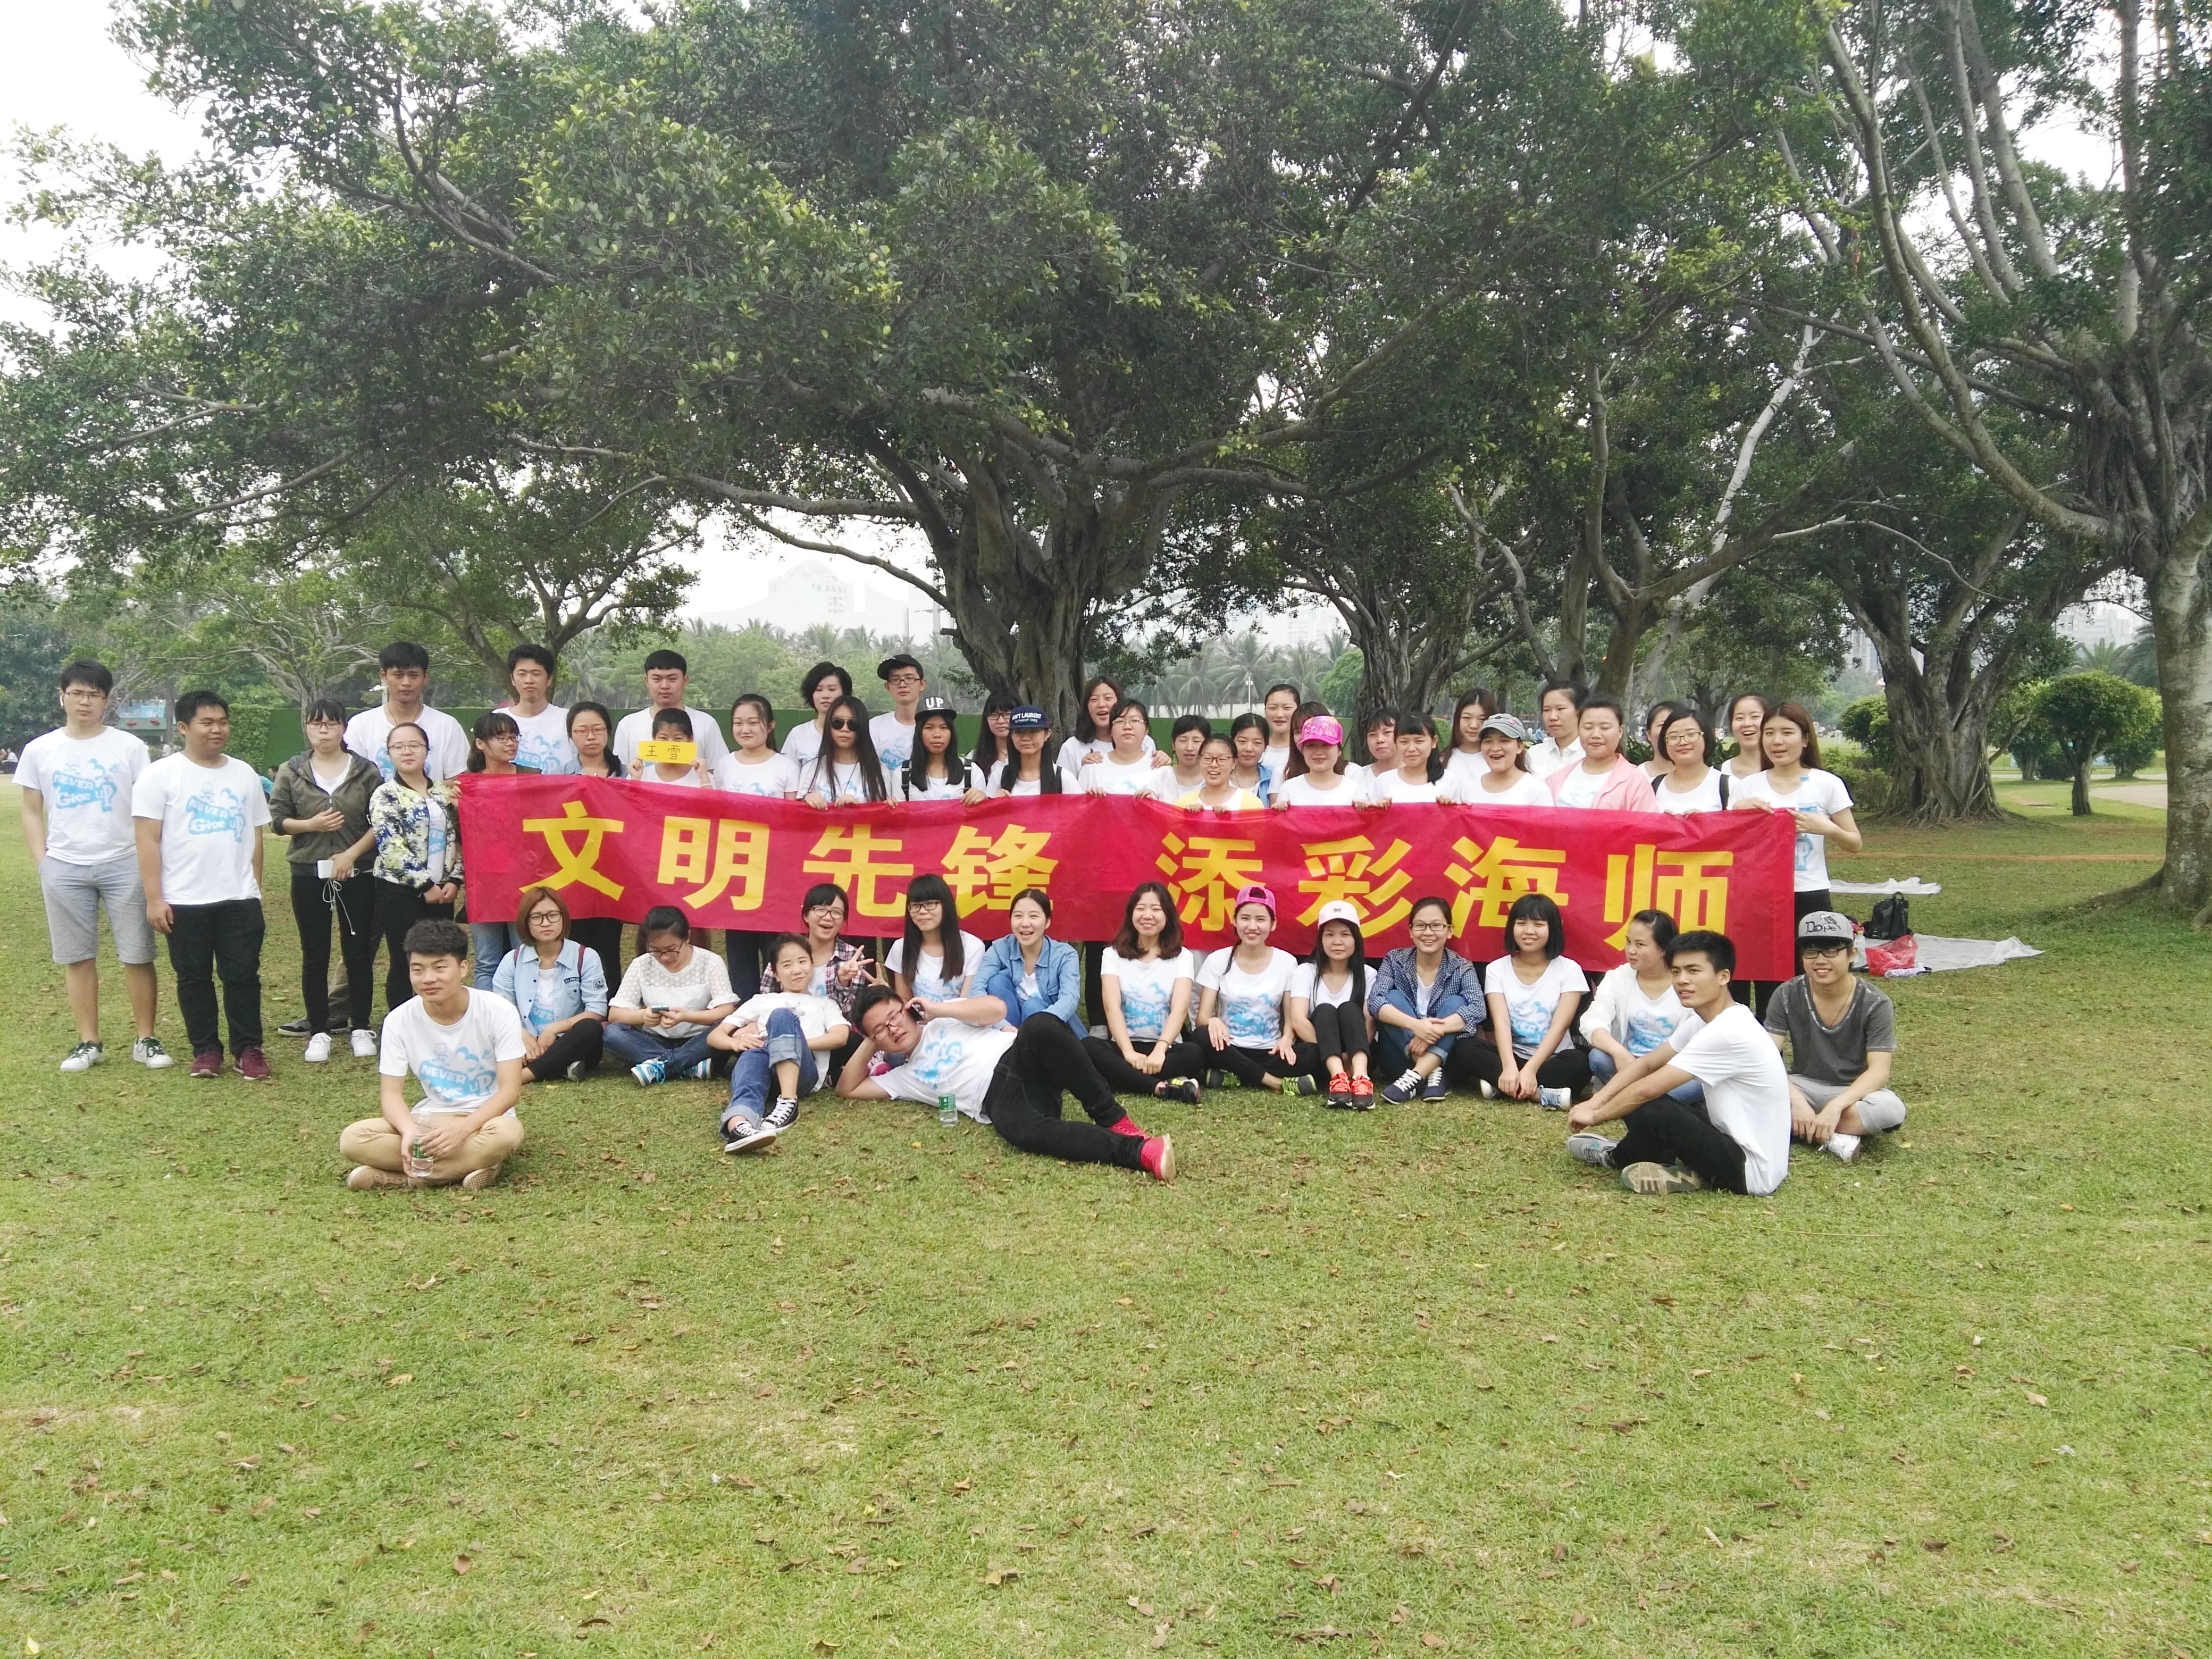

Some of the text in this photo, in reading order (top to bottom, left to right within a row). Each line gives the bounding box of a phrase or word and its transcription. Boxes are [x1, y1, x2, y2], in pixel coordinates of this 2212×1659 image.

[926, 697, 944, 708] UP
[53, 774, 94, 790] NEVER
[189, 799, 229, 819] NEVER
[519, 801, 1733, 952] 文明先锋 添彩海师
[1806, 921, 1837, 934] Dope
[421, 1065, 467, 1084] NEVER
